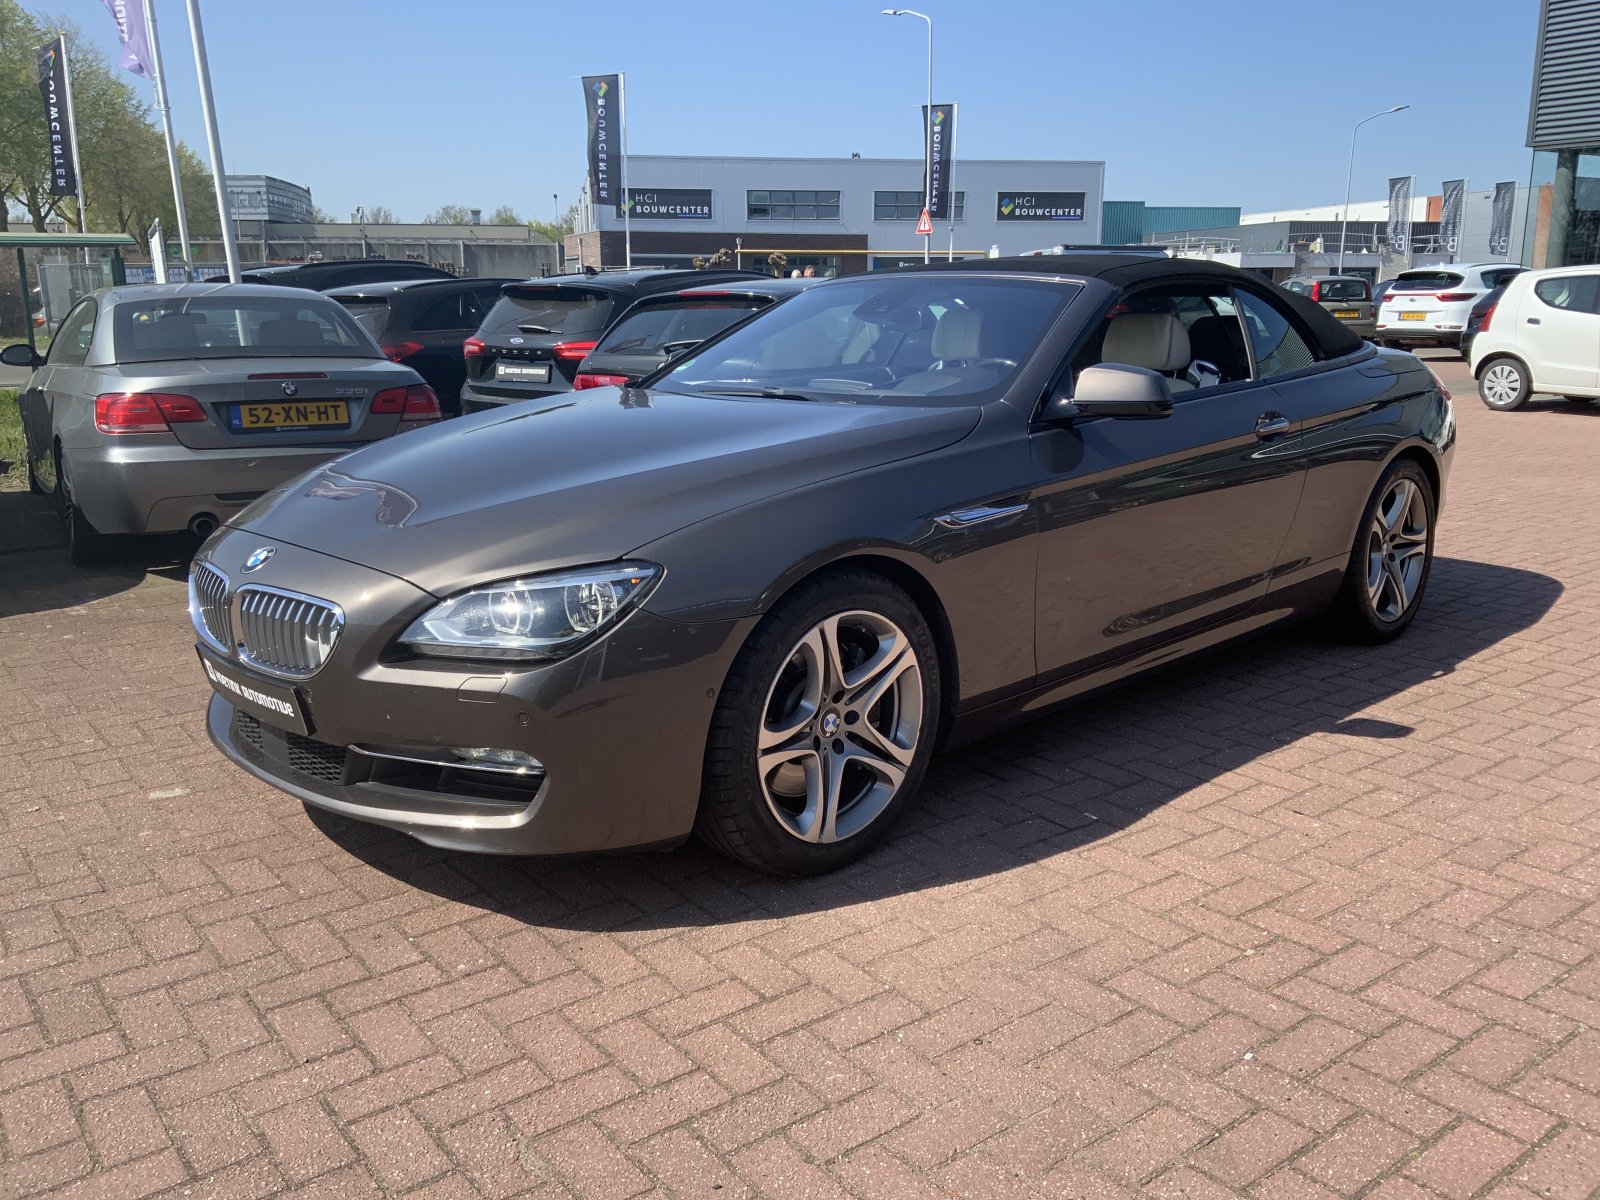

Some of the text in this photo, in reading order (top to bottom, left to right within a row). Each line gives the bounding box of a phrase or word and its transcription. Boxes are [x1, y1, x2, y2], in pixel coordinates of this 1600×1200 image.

[636, 205, 709, 214] BOUWCENTER
[1015, 208, 1082, 216] BOUWCENTER
[248, 404, 341, 425] 52-XN-HT
